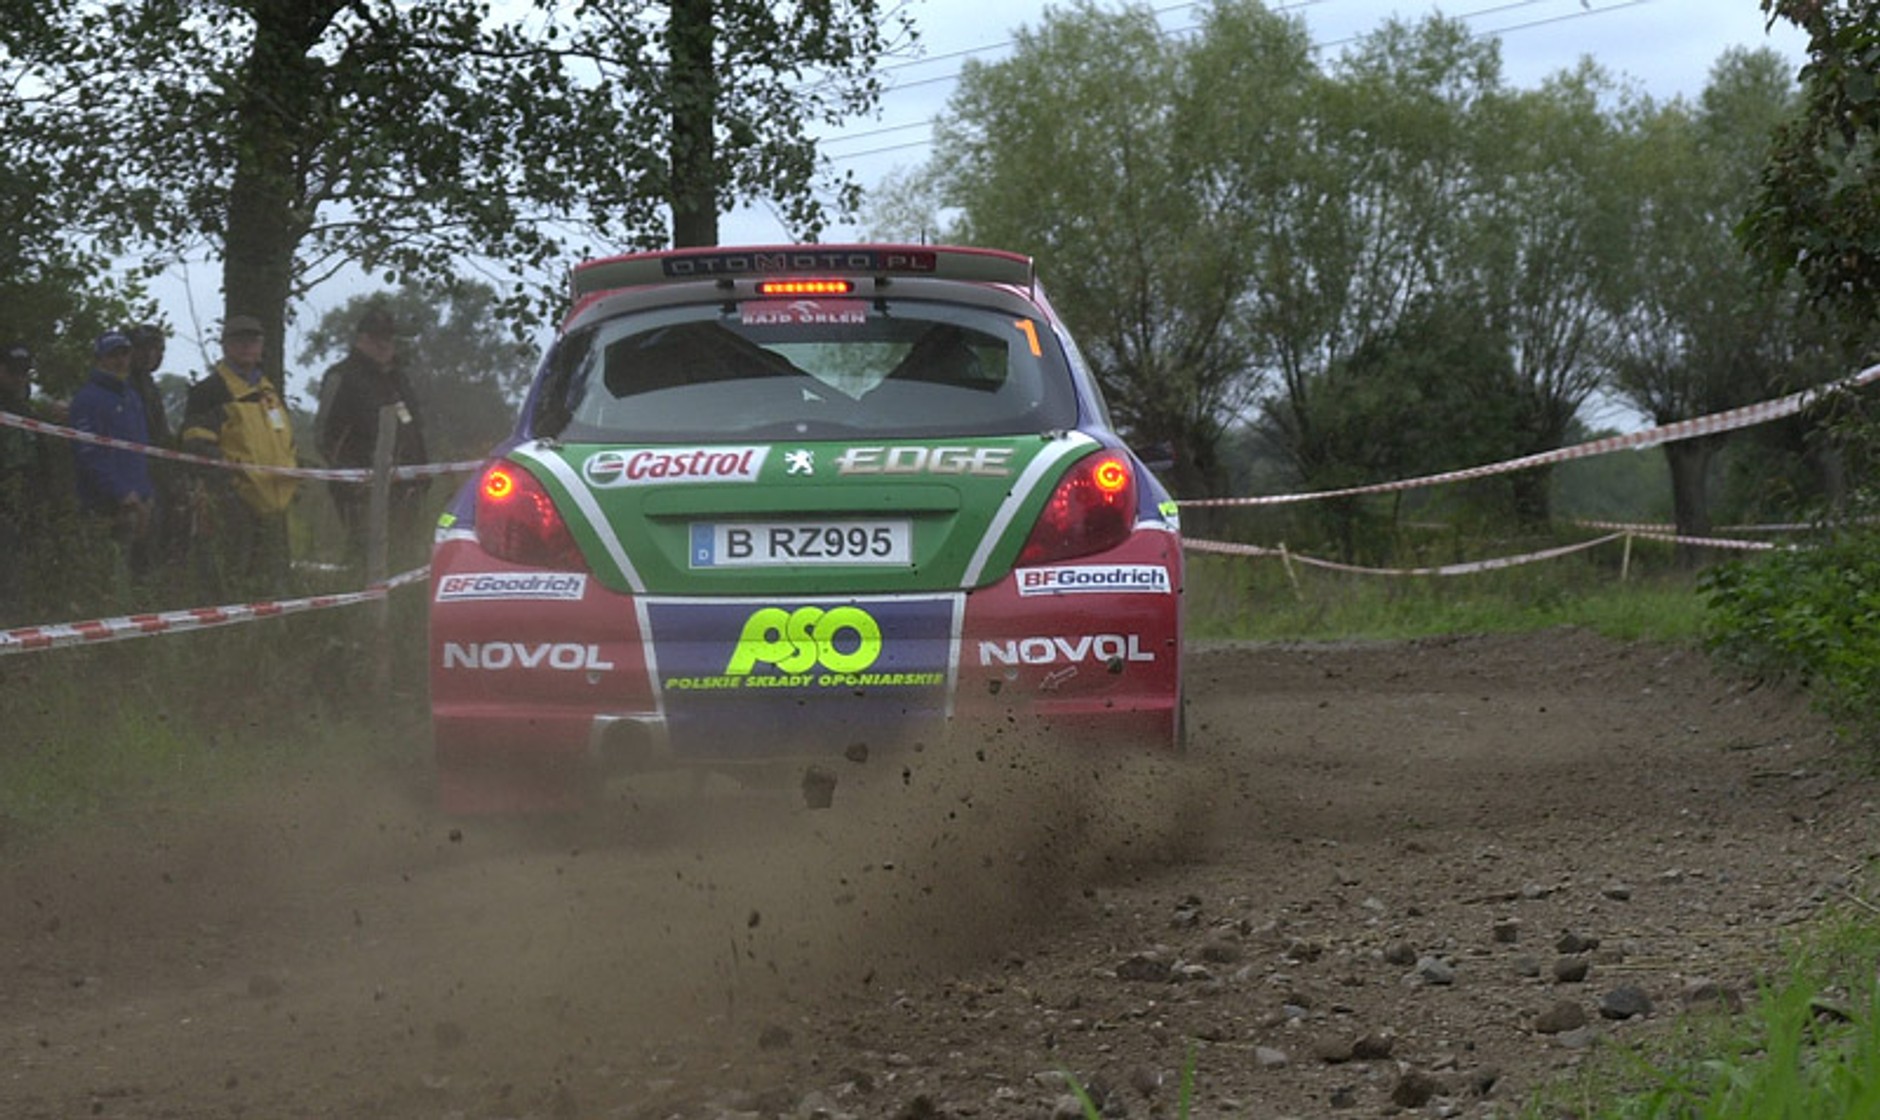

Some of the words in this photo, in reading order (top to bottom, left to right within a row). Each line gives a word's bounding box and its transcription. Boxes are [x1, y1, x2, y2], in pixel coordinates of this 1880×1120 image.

[742, 313, 794, 325] RAJD
[799, 312, 866, 324] ORLEN
[1013, 319, 1042, 357] 1
[626, 450, 754, 480] Castrol
[834, 446, 1014, 476] EDGE
[697, 549, 709, 561] D
[726, 529, 754, 558] B
[768, 527, 893, 558] RZ995
[442, 574, 582, 594] BFGoodrich
[1023, 568, 1166, 587] BFGoodrich
[725, 606, 883, 675] PSO
[977, 634, 1155, 667] NOVOL
[443, 641, 615, 671] NOVOL
[665, 675, 742, 690] POLSKIE
[818, 672, 945, 687] OPONIARSKIE
